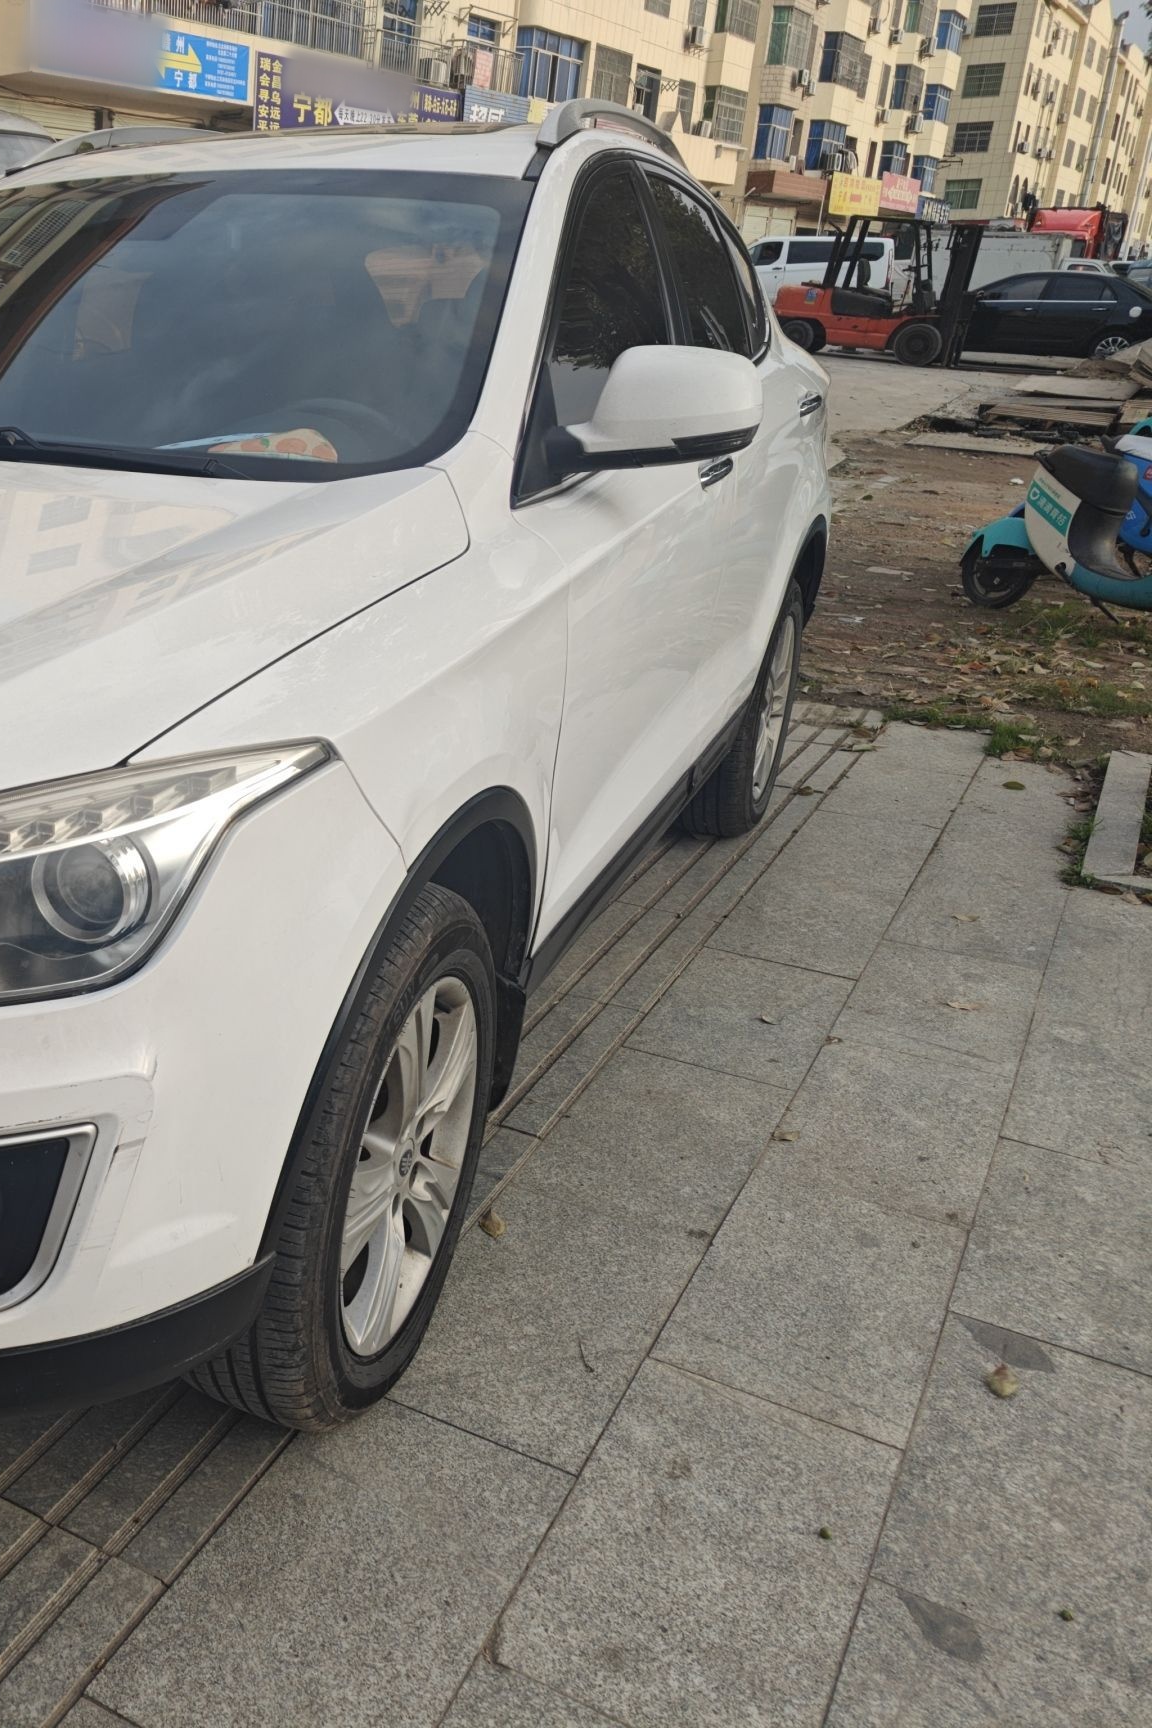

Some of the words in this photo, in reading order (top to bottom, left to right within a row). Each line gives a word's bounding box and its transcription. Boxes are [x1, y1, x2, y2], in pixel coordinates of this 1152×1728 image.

[259, 57, 283, 74] 瑞金
[259, 73, 282, 90] 会昌
[258, 89, 282, 105] 寻乌
[258, 104, 281, 120] 安远
[293, 91, 333, 127] 宁都
